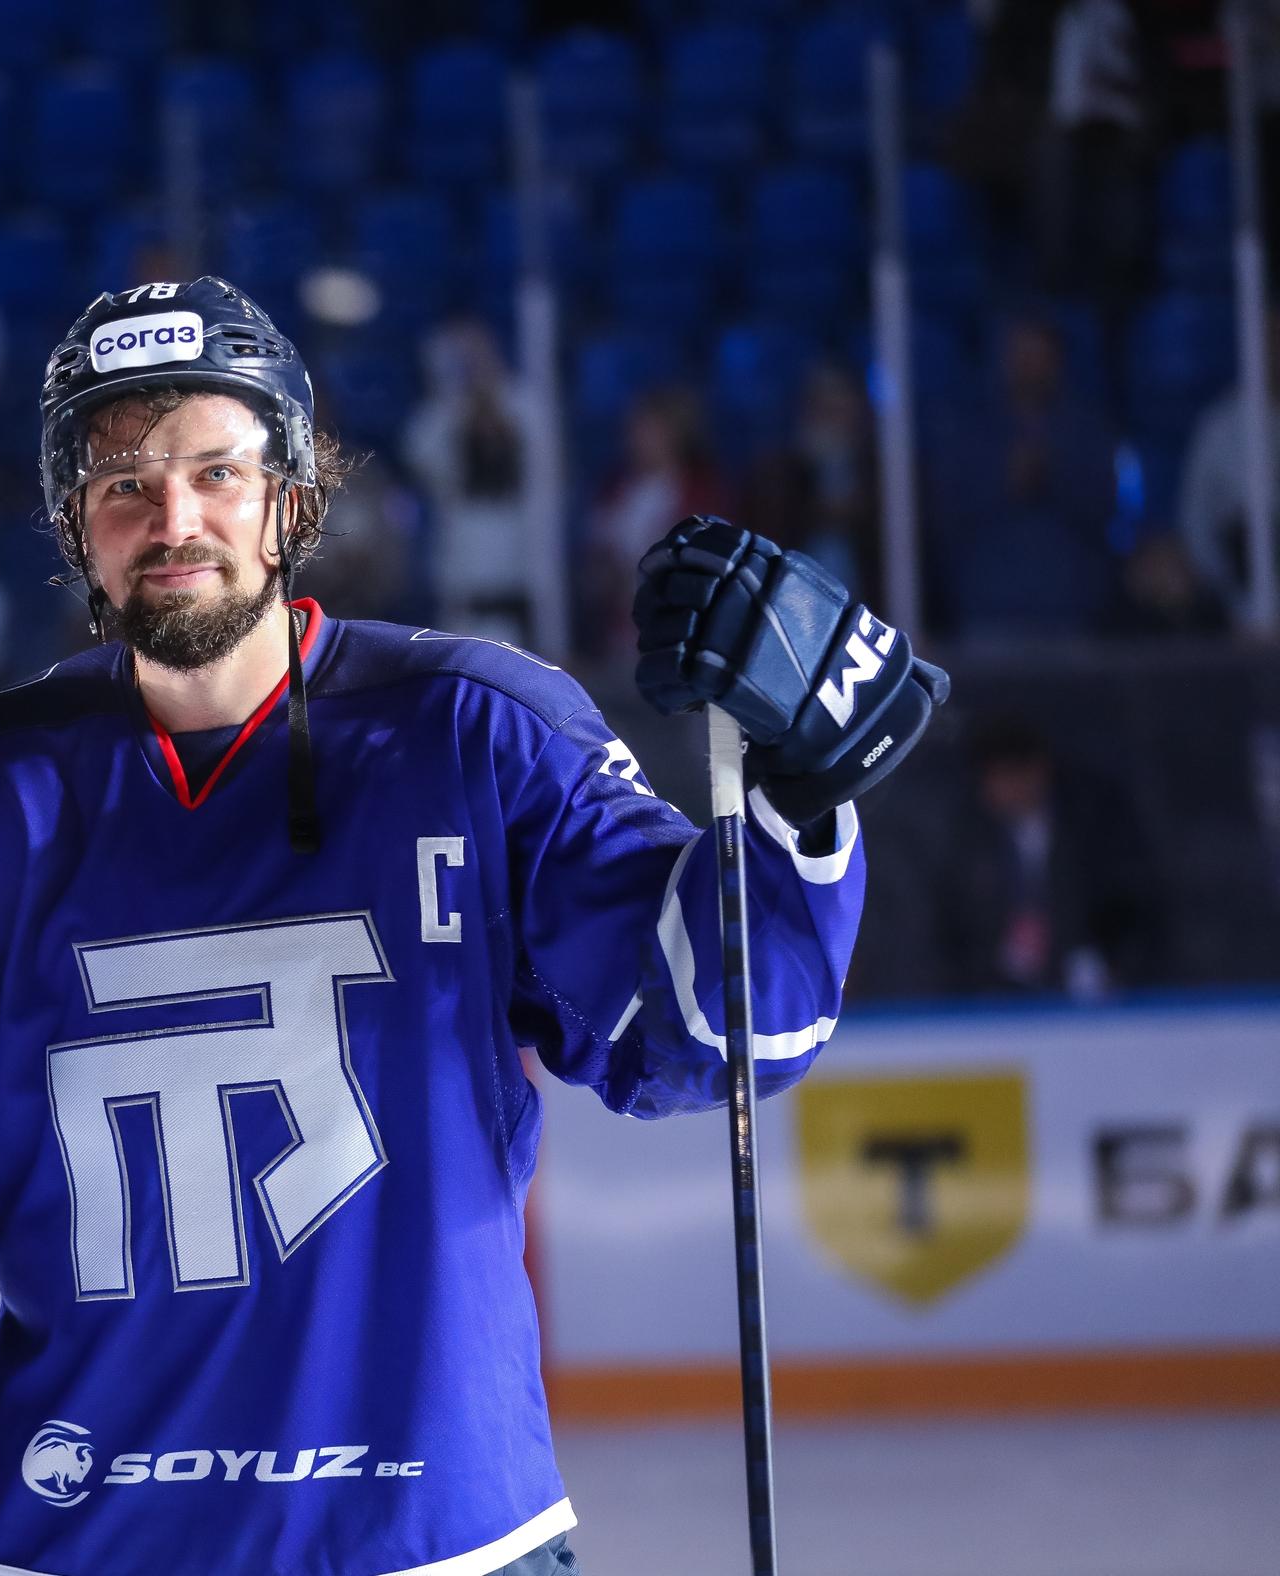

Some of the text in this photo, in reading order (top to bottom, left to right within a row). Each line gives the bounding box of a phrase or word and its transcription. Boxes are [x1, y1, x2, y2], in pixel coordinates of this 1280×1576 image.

[95, 327, 195, 356] согаз
[862, 736, 893, 767] BUGOR
[417, 836, 464, 943] C
[104, 1445, 425, 1484] SOYUZ BC
